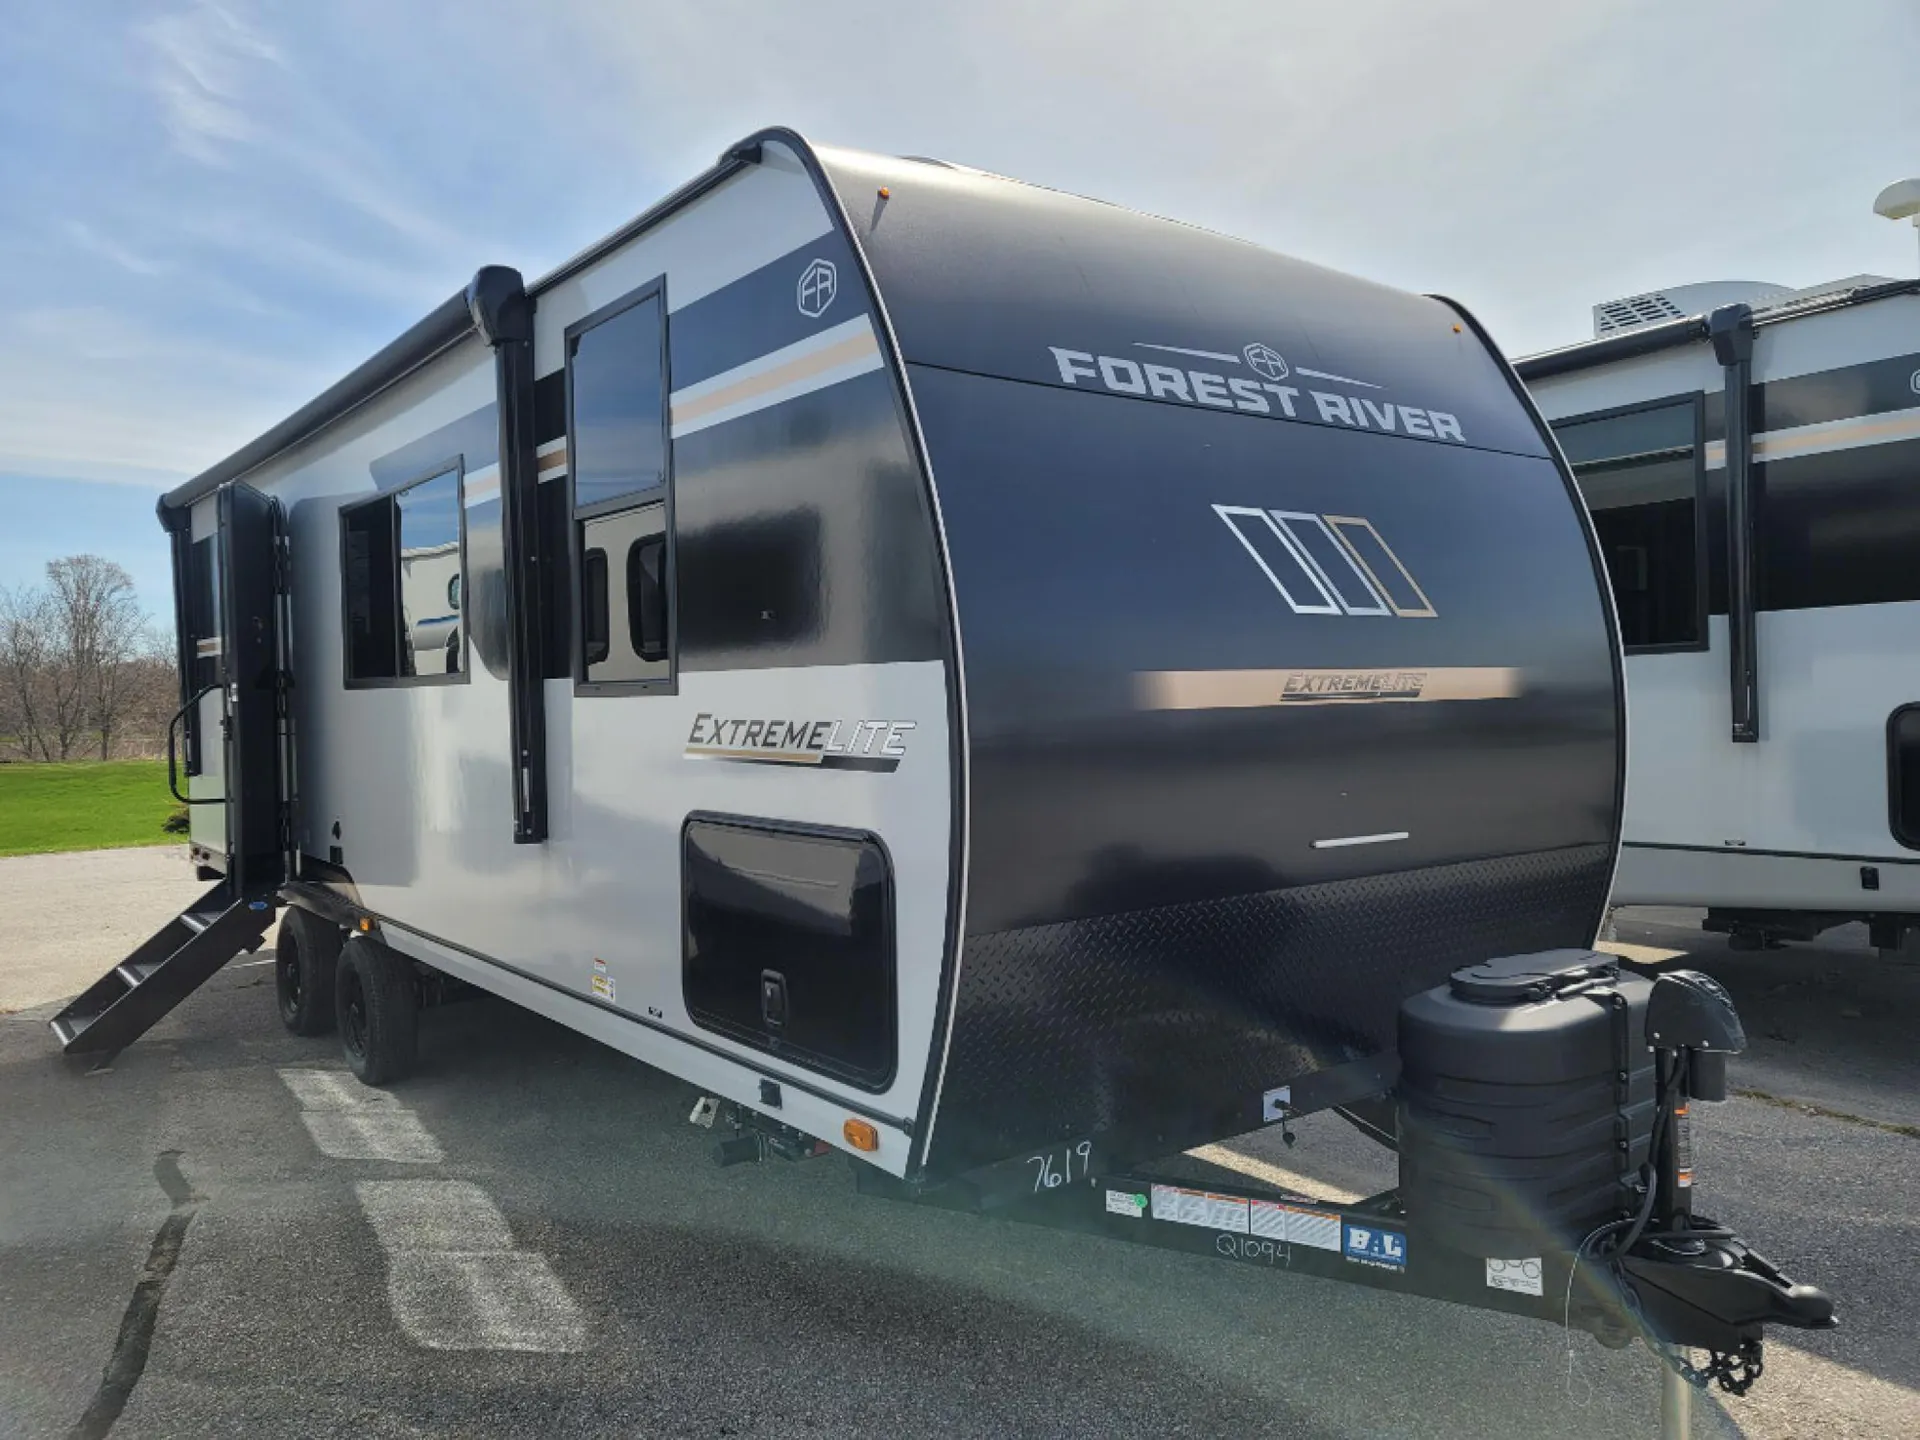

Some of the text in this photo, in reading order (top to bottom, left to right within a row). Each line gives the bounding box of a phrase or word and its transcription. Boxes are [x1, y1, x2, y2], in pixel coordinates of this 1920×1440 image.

[1048, 346, 1466, 443] FOREST RIVER
[1216, 1233, 1291, 1268] Q1094
